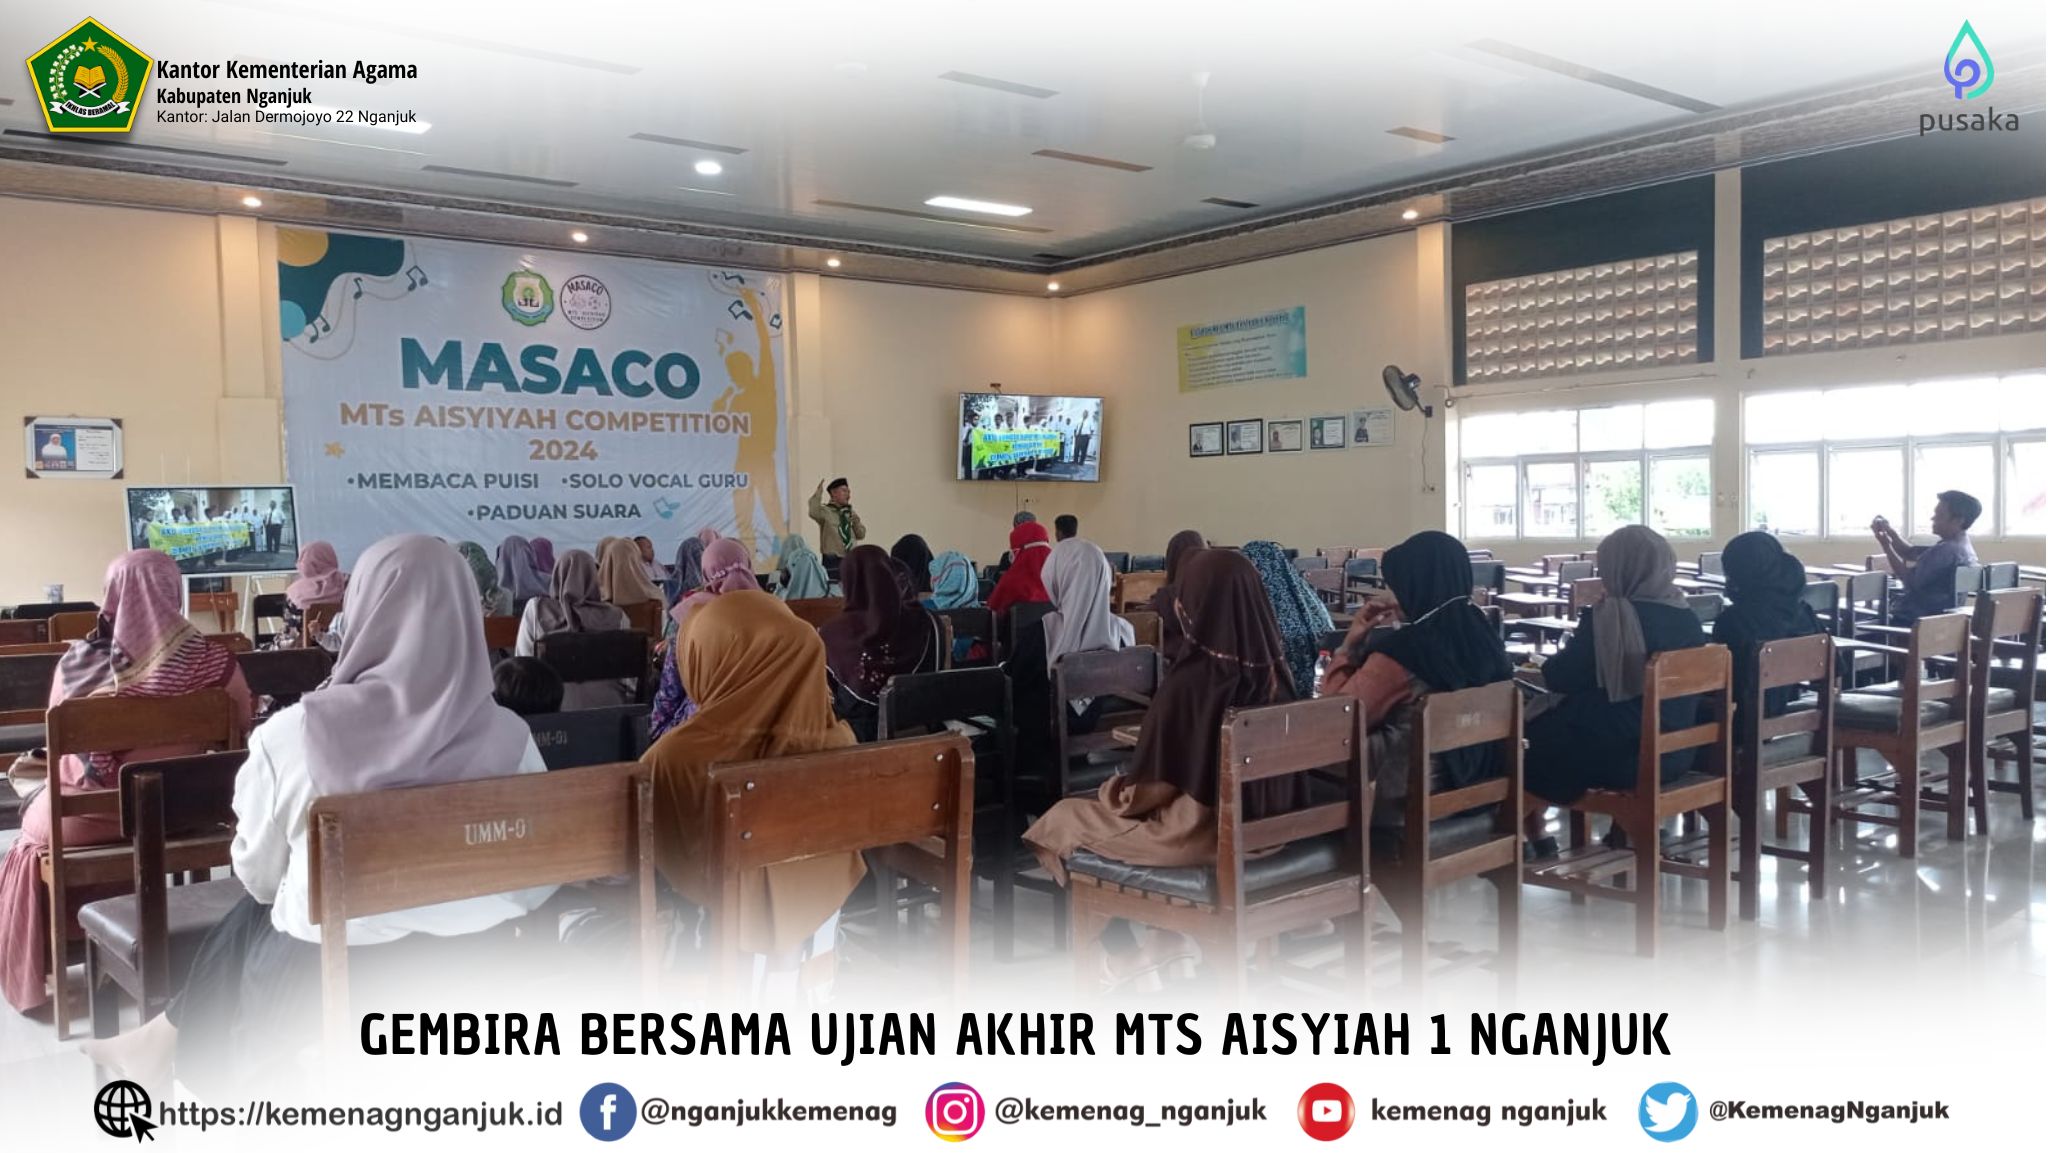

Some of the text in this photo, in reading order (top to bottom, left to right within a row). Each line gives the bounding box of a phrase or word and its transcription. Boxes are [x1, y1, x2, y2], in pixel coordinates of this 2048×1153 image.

[567, 281, 604, 295] MASACO
[400, 337, 702, 400] MASACO
[339, 402, 751, 435] MTs AISYIYAH COMPETITION
[528, 438, 599, 461] 2024
[483, 473, 540, 490] PUISI
[628, 472, 693, 489] VOCAL
[698, 473, 749, 489] GURU
[573, 502, 642, 520] SUARA
